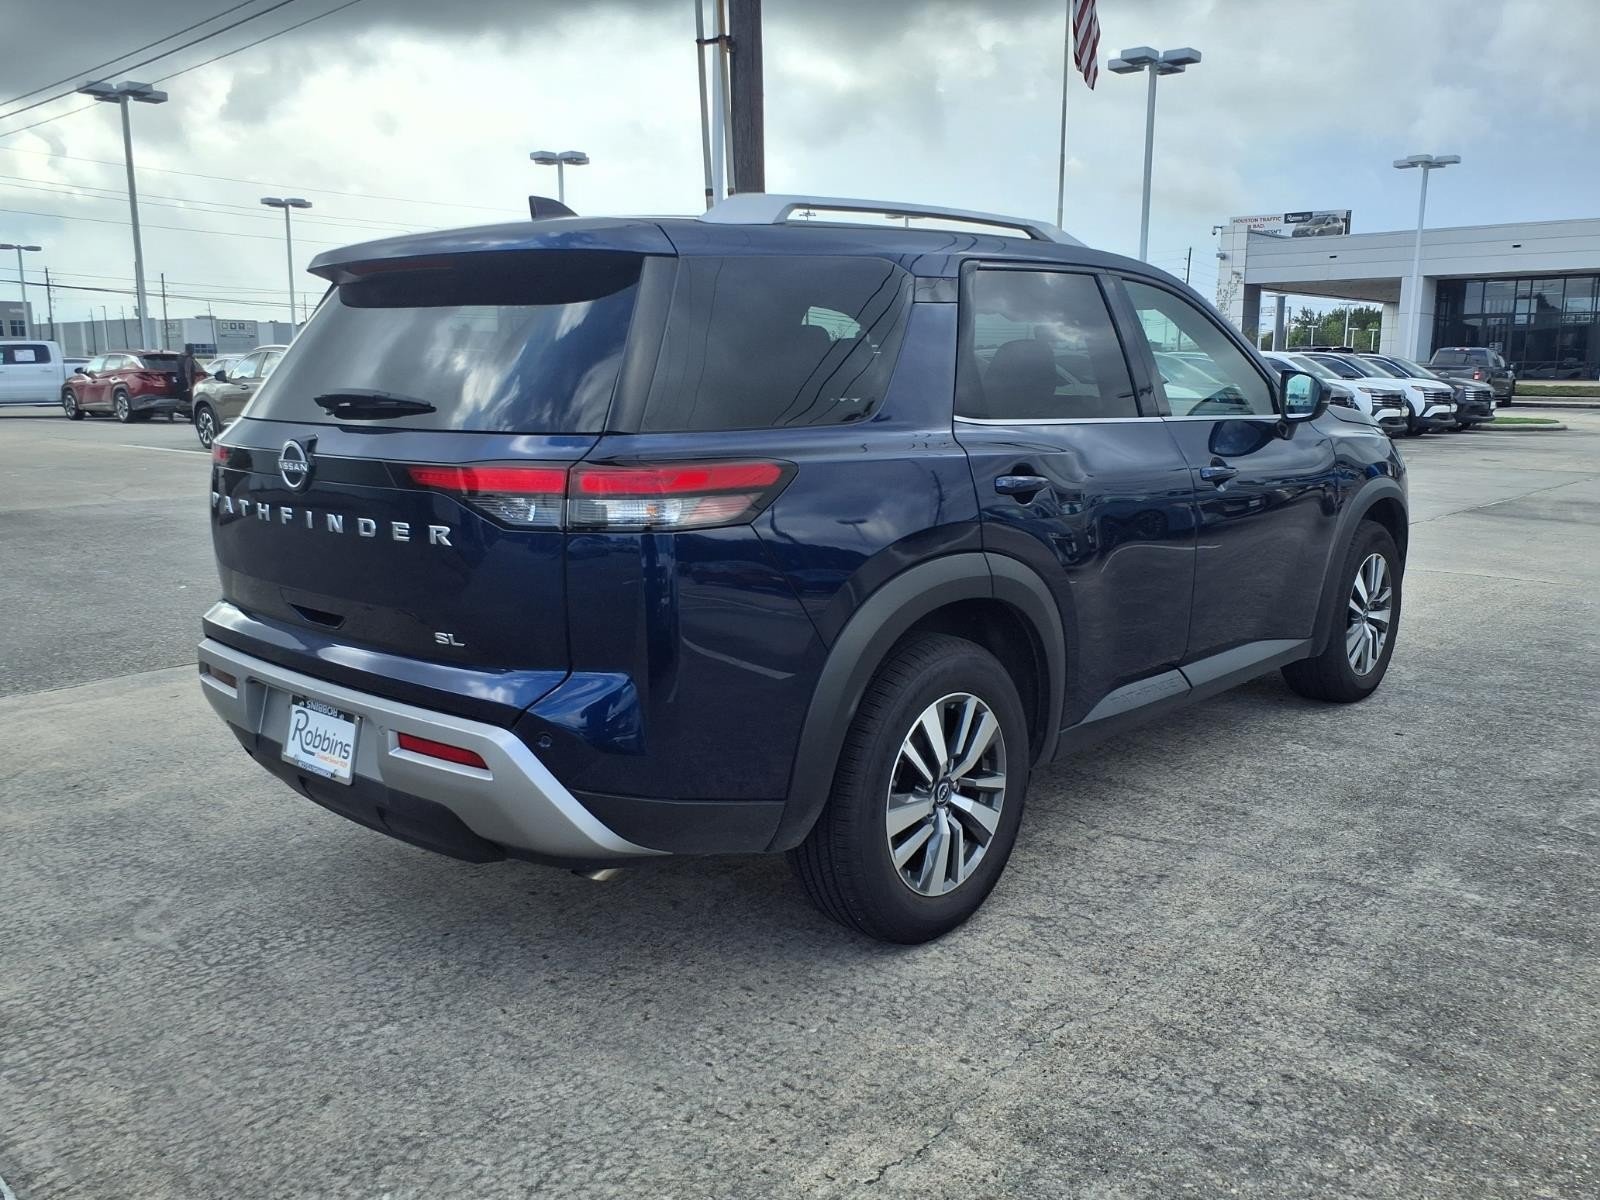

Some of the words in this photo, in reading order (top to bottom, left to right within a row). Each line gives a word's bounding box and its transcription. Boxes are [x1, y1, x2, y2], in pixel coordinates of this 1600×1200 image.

[279, 461, 308, 472] NISSAN
[212, 491, 452, 546] PATHFINDER
[434, 632, 465, 646] SL
[306, 700, 338, 717] ROBBINS
[292, 709, 351, 760] Robbins
